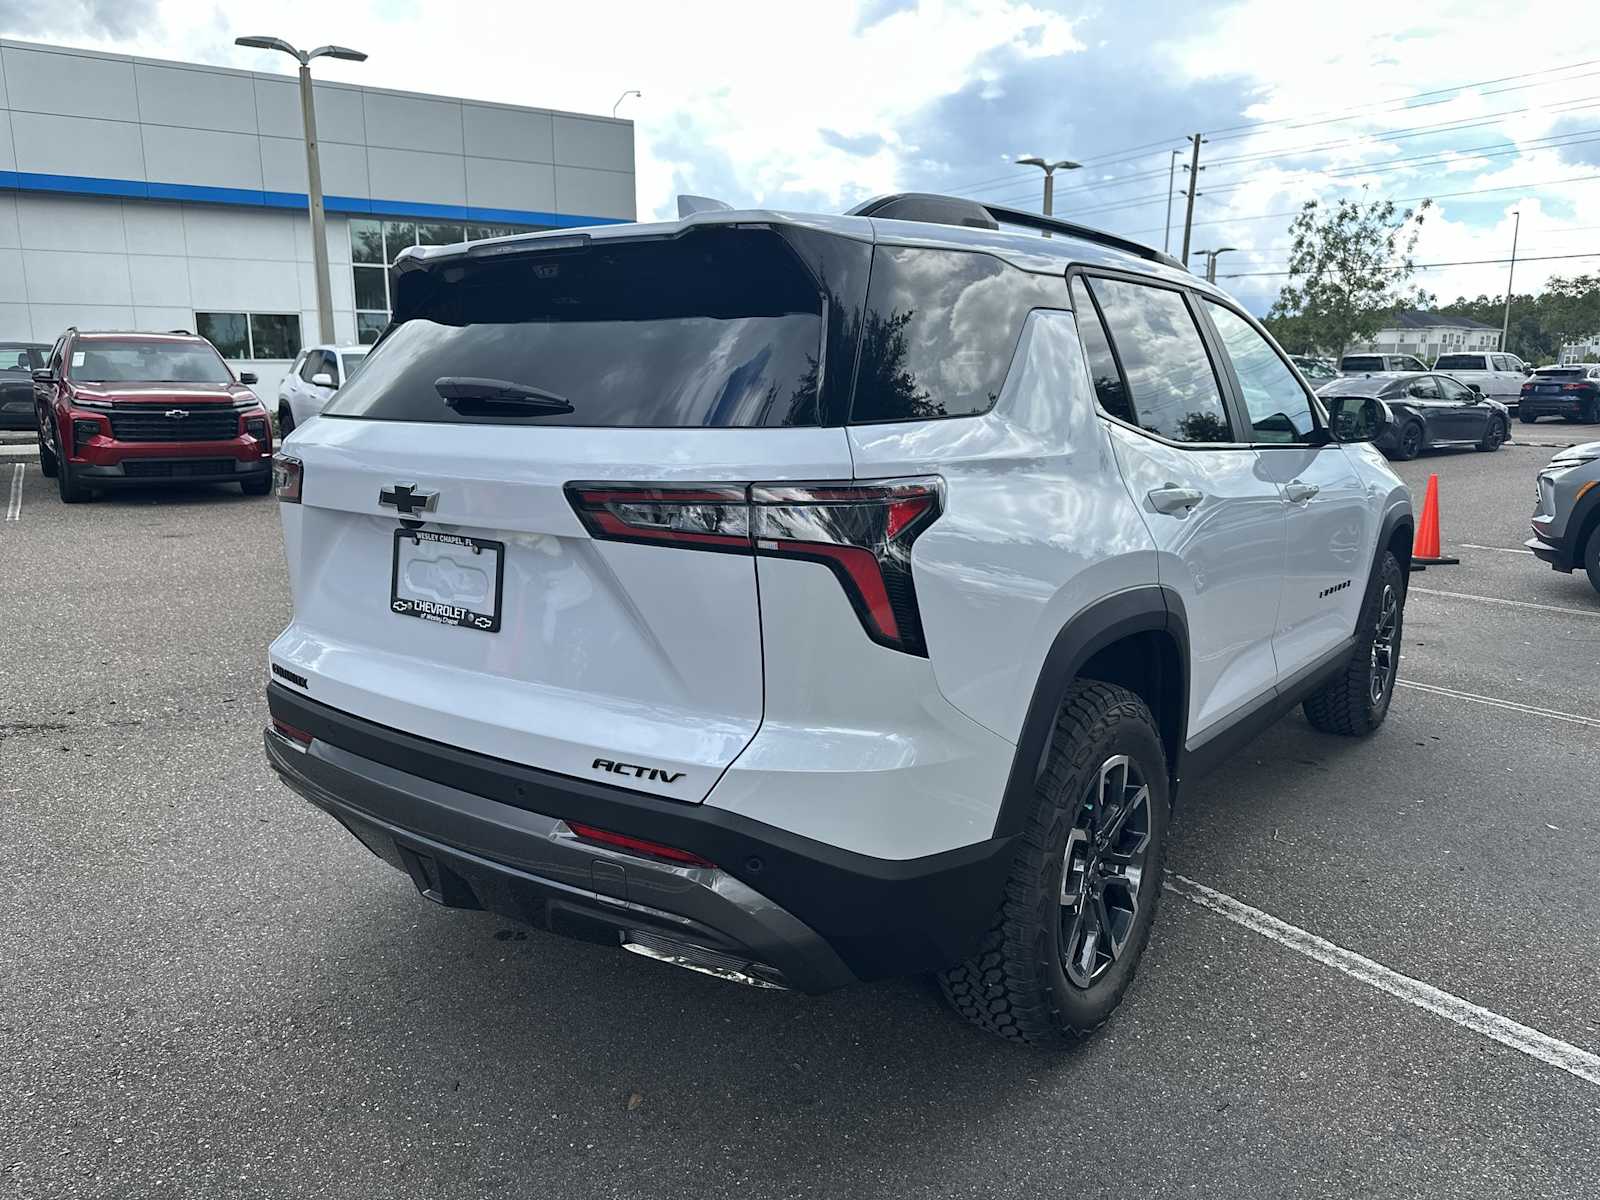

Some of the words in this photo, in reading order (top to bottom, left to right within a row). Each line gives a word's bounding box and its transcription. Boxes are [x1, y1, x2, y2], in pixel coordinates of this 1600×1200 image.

[415, 531, 439, 541] WESLEY
[465, 538, 474, 546] FL
[414, 599, 467, 620] CHEVROLET
[591, 757, 687, 783] ACTIV
